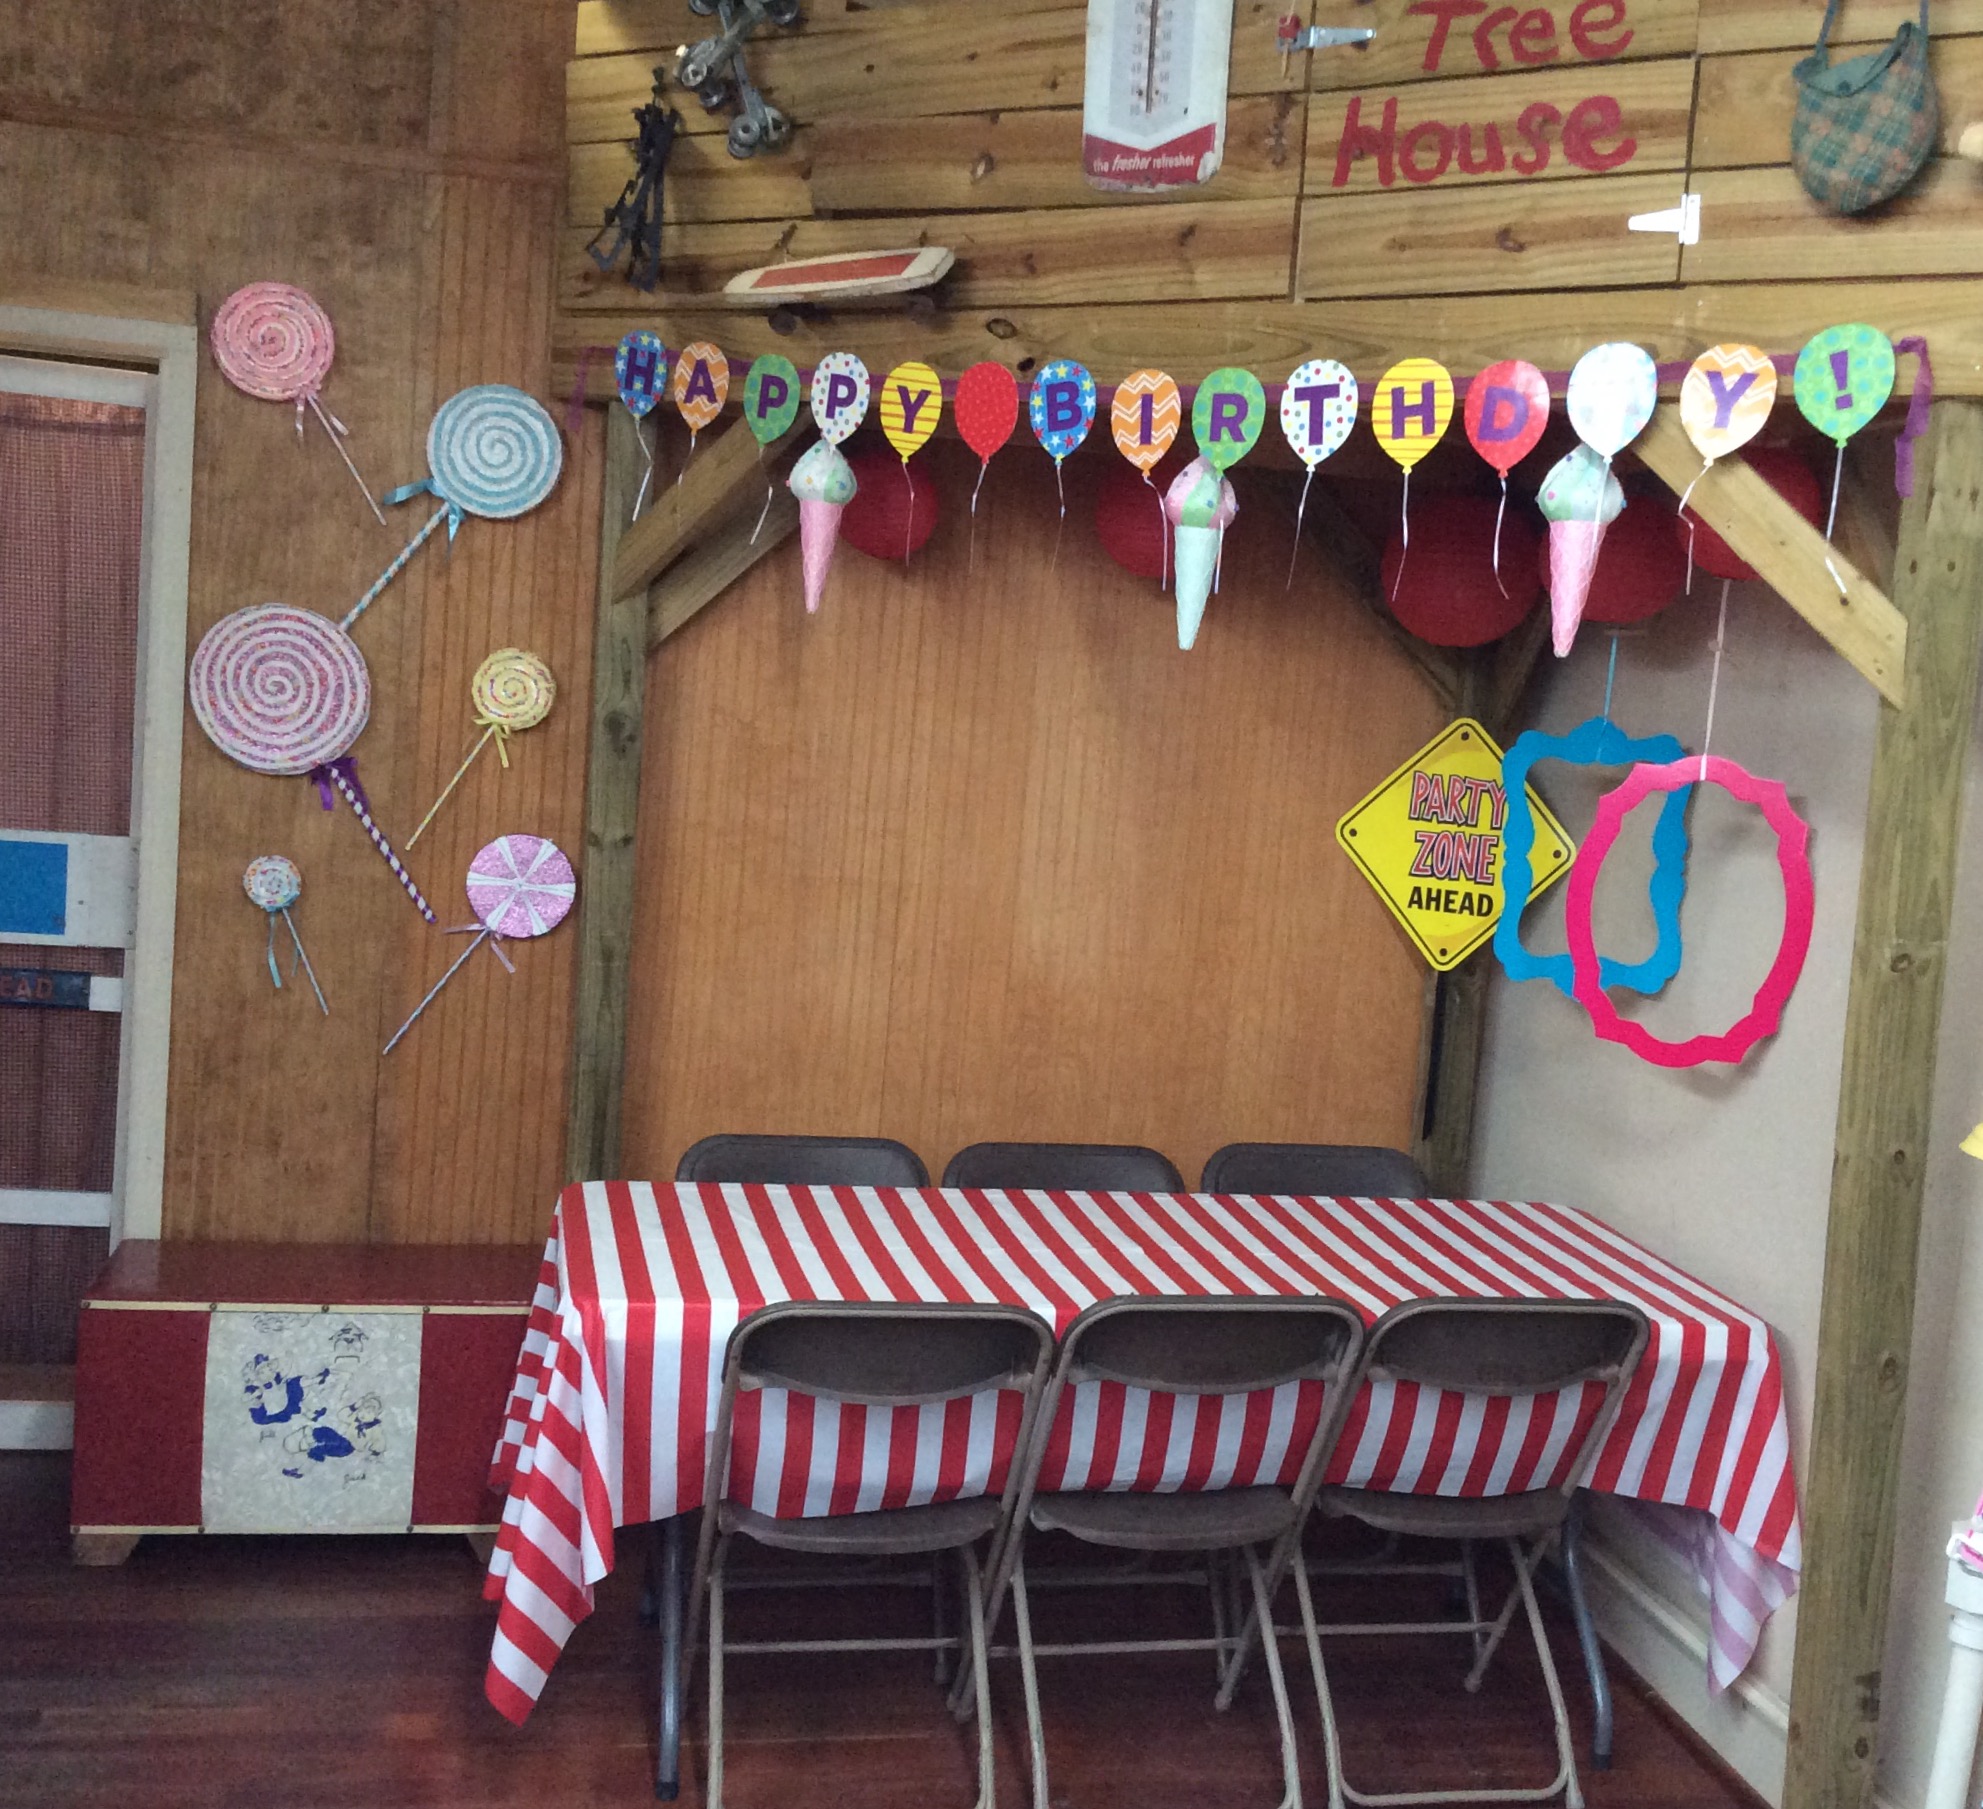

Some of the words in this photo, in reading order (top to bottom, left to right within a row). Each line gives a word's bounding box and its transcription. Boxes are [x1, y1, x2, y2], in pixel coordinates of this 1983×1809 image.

[1409, 0, 1634, 71] Tree
[1093, 157, 1109, 173] the
[1112, 153, 1152, 172] fresher
[1153, 151, 1195, 169] refresher
[1332, 95, 1637, 187] House
[624, 345, 931, 434] HAPPY
[1045, 349, 1853, 447] BIRTHDY!
[1408, 770, 1507, 830] PARTY
[1408, 830, 1498, 886] ZONE
[1407, 885, 1494, 918] AHEAD
